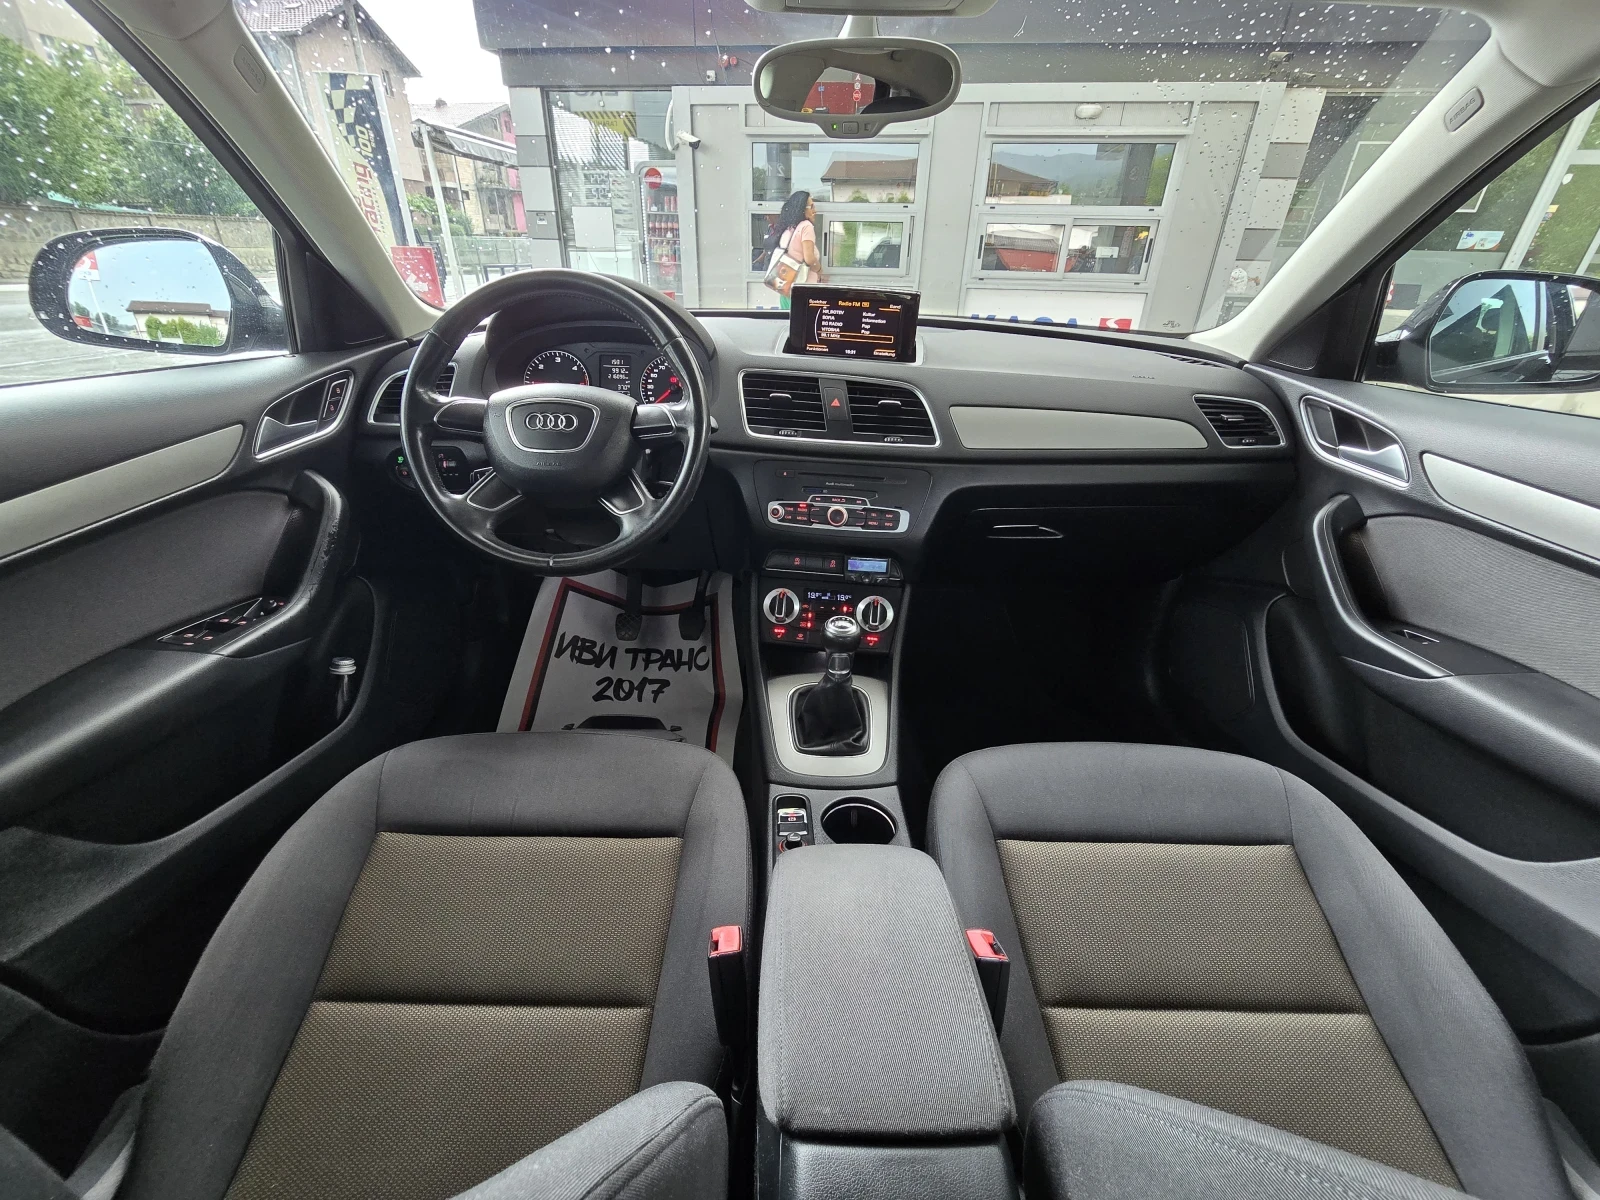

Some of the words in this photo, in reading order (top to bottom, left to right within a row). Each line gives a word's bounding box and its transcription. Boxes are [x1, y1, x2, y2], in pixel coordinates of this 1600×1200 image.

[1449, 97, 1476, 125] AIRBAG
[355, 123, 374, 158] 100
[553, 631, 618, 671] ИВИ
[624, 645, 711, 672] ТРАНС
[592, 676, 671, 704] 2017
